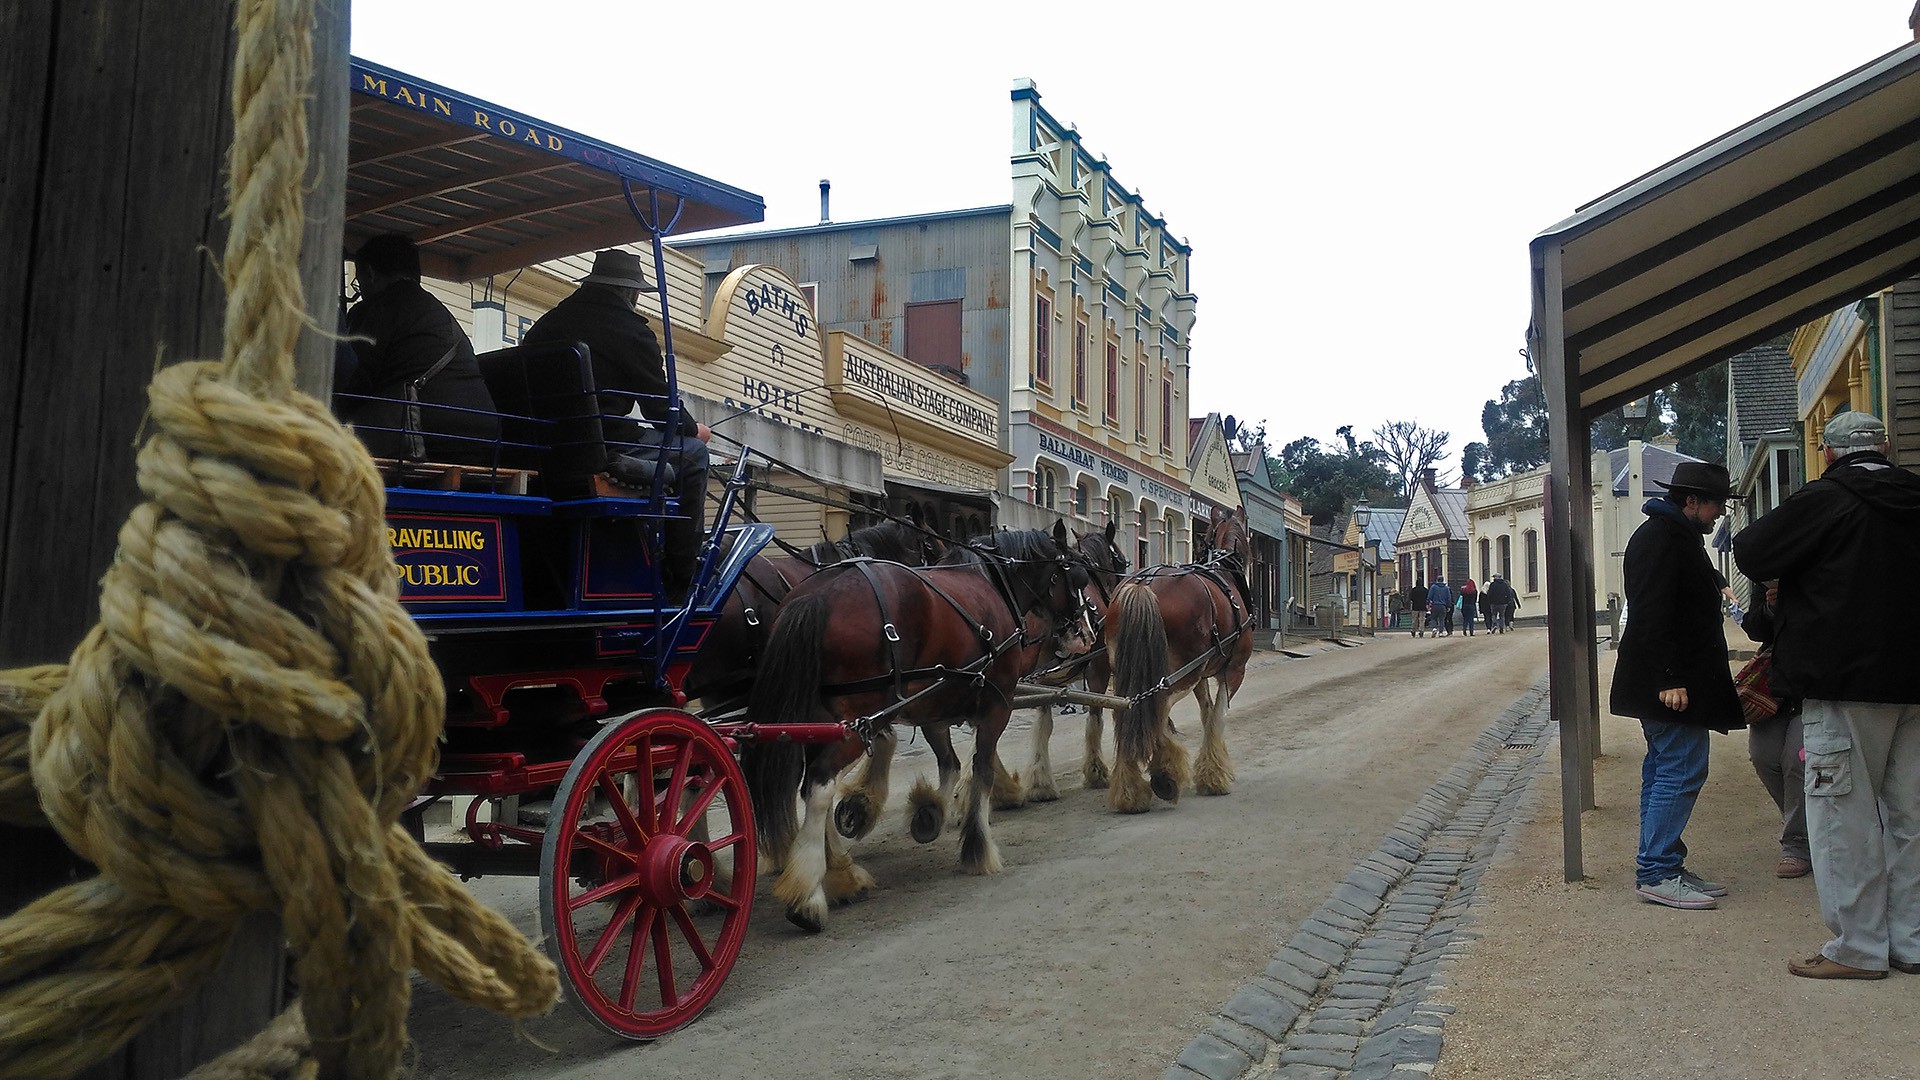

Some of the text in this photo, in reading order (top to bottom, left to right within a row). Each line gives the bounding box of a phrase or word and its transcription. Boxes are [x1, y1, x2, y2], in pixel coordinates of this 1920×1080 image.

[362, 73, 564, 152] MAIN ROAD
[745, 284, 808, 338] BATH'S
[743, 376, 804, 416] HOTEL
[845, 353, 914, 405] AUSTRALIAN
[916, 384, 948, 418] STAGE
[1039, 433, 1096, 471] BALLARAT
[1100, 461, 1129, 485] TIMES
[1148, 483, 1183, 506] SPENCER
[386, 528, 485, 550] RAVELLING
[1491, 510, 1506, 518] OFFICE
